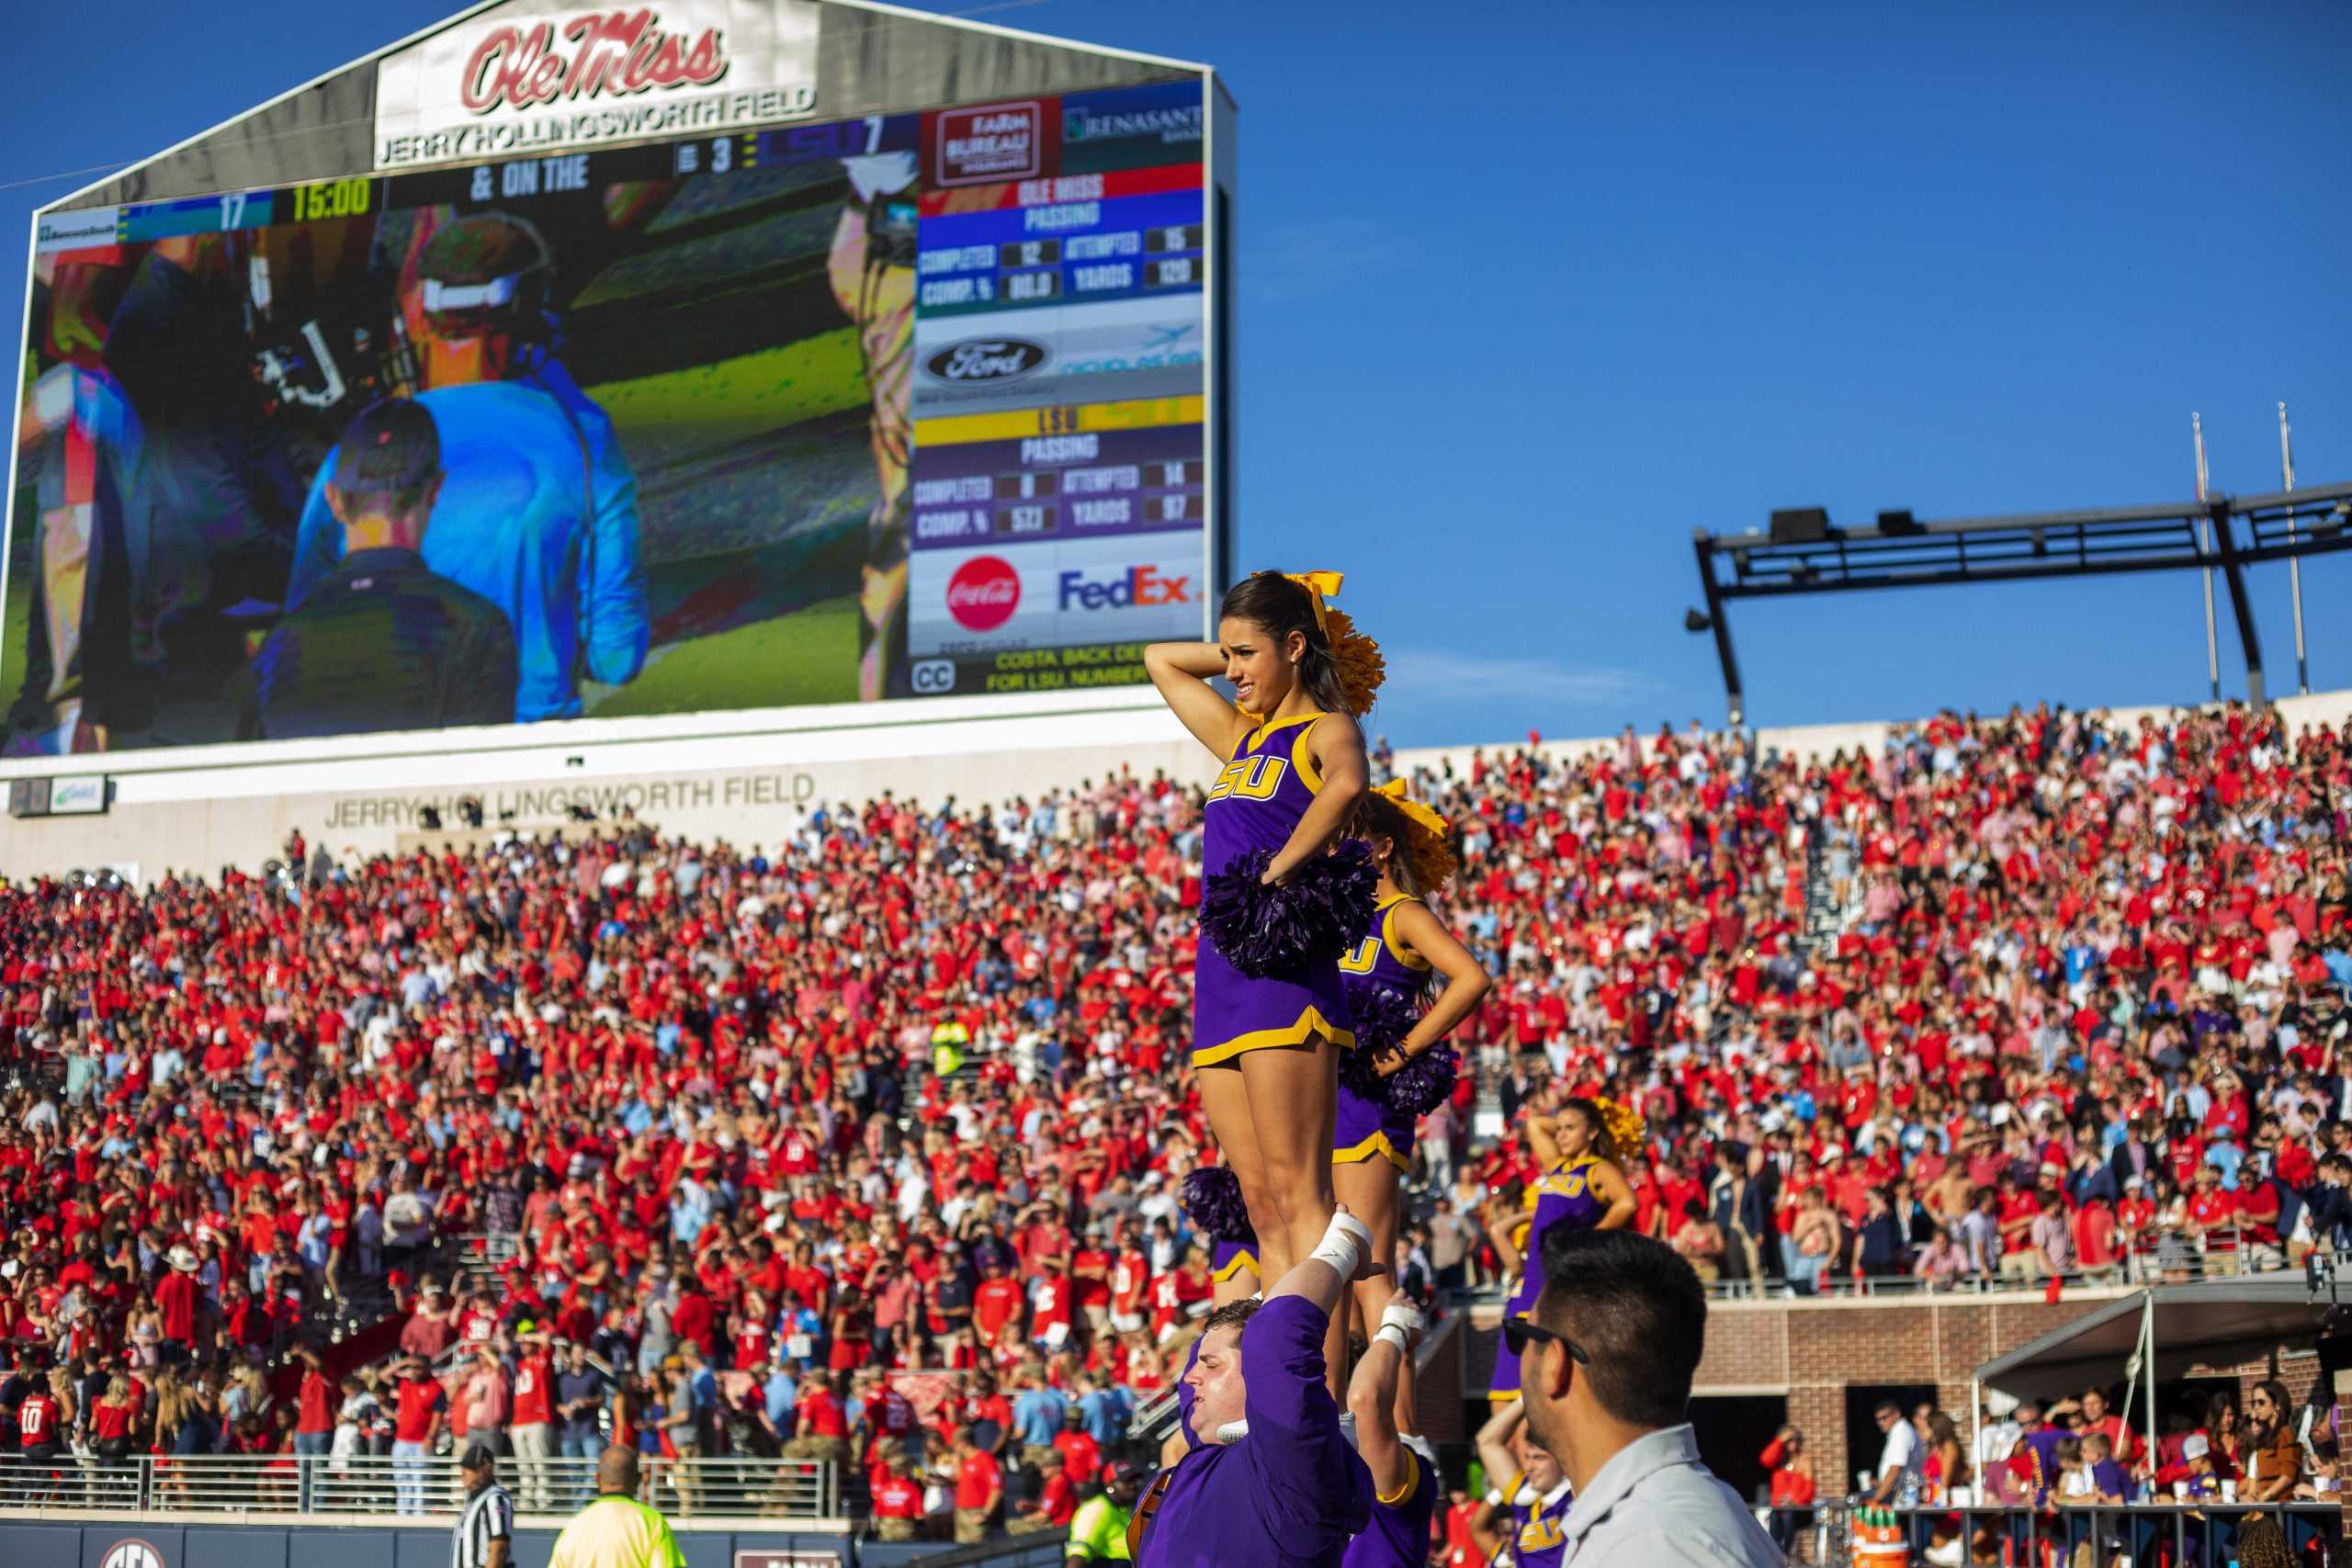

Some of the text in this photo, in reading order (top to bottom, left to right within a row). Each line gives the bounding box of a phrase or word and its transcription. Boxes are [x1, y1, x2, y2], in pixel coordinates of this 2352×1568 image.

[462, 8, 731, 115] Ole Miss
[379, 87, 816, 164] JERRY HOLLINGSWORTH FIELD
[865, 116, 884, 154] 7
[971, 113, 1031, 134] FARM
[1085, 105, 1202, 137] RENASANT
[711, 138, 732, 174] 3
[944, 131, 1031, 161] BUREAU
[470, 154, 588, 201] & ON THE
[1017, 173, 1104, 207] OLE MISS
[220, 195, 247, 231] 17
[294, 179, 370, 221] 15:00
[1024, 201, 1101, 231] PASSING
[918, 243, 997, 275] COMPLETED
[1064, 230, 1142, 261] ATTEMPTED
[1073, 262, 1133, 292] YARDS
[944, 343, 1028, 378] Ford
[1038, 406, 1079, 434] LSU
[1021, 433, 1100, 464] PASSING
[913, 475, 993, 506] COMPLETED
[1061, 465, 1140, 494] ATTEMPTED
[1071, 497, 1132, 527] YARDS
[1059, 565, 1190, 612] FedEx
[995, 649, 1057, 671] COSTA
[1062, 646, 1111, 666] BACK
[918, 666, 949, 689] CC
[986, 672, 1027, 692] FOR
[1028, 671, 1065, 690] LSU
[324, 795, 421, 829] JERRY
[723, 773, 816, 807] FIELD
[21, 1406, 42, 1434] 10
